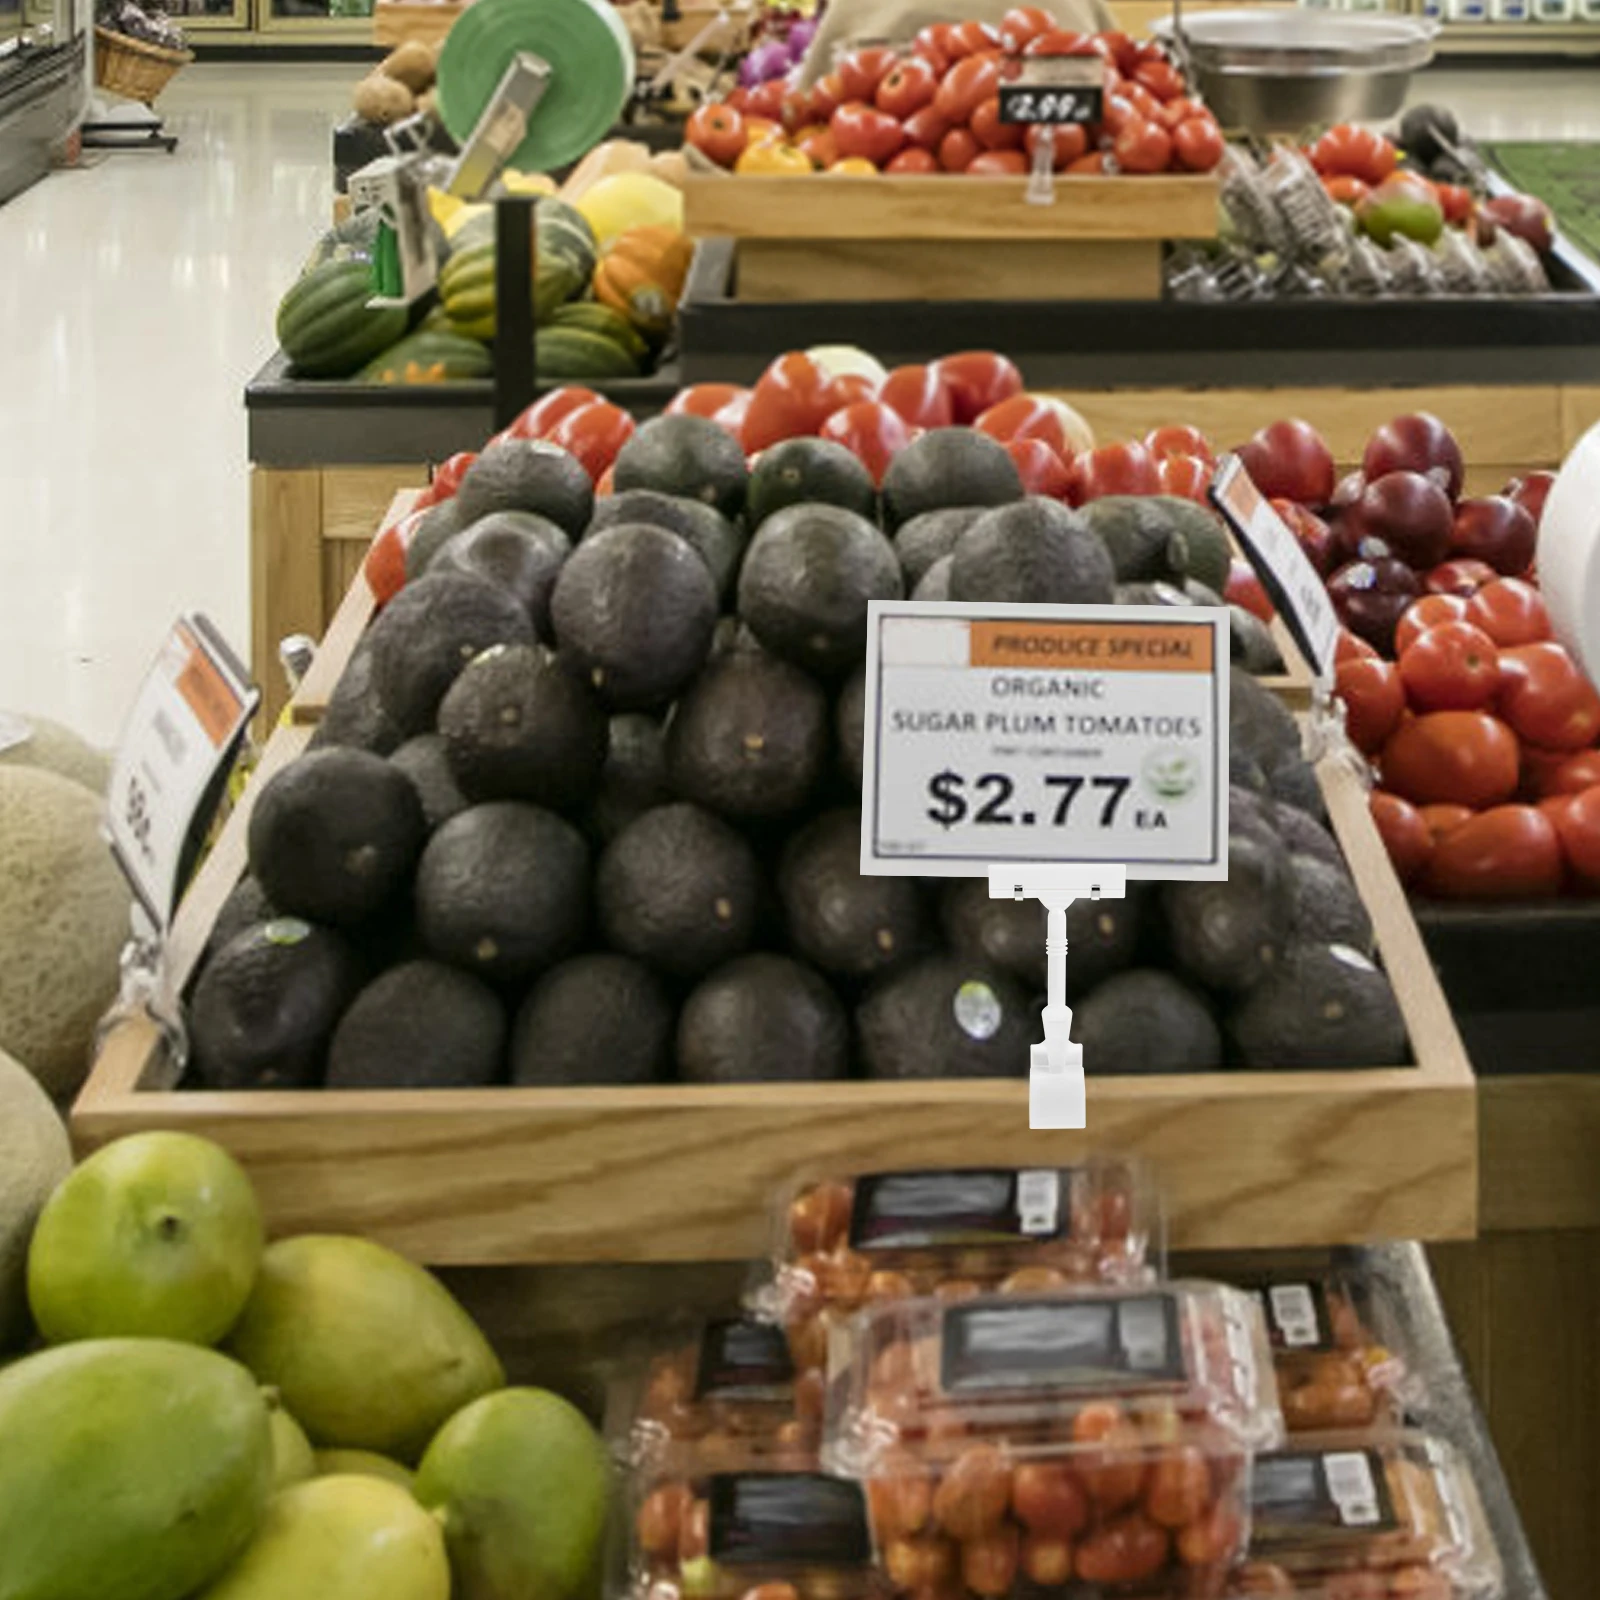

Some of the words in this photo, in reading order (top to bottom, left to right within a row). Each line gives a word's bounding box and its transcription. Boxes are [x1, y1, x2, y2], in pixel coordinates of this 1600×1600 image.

[993, 634, 1100, 659] PRODUCE
[1108, 637, 1193, 660] SPECIAL
[991, 676, 1105, 698] ORGANIC
[892, 710, 977, 733] SUGAR
[985, 712, 1057, 734] PLUM
[1065, 715, 1202, 737] TOMATOES
[926, 768, 1131, 831] $2.77
[1135, 809, 1168, 829] EA
